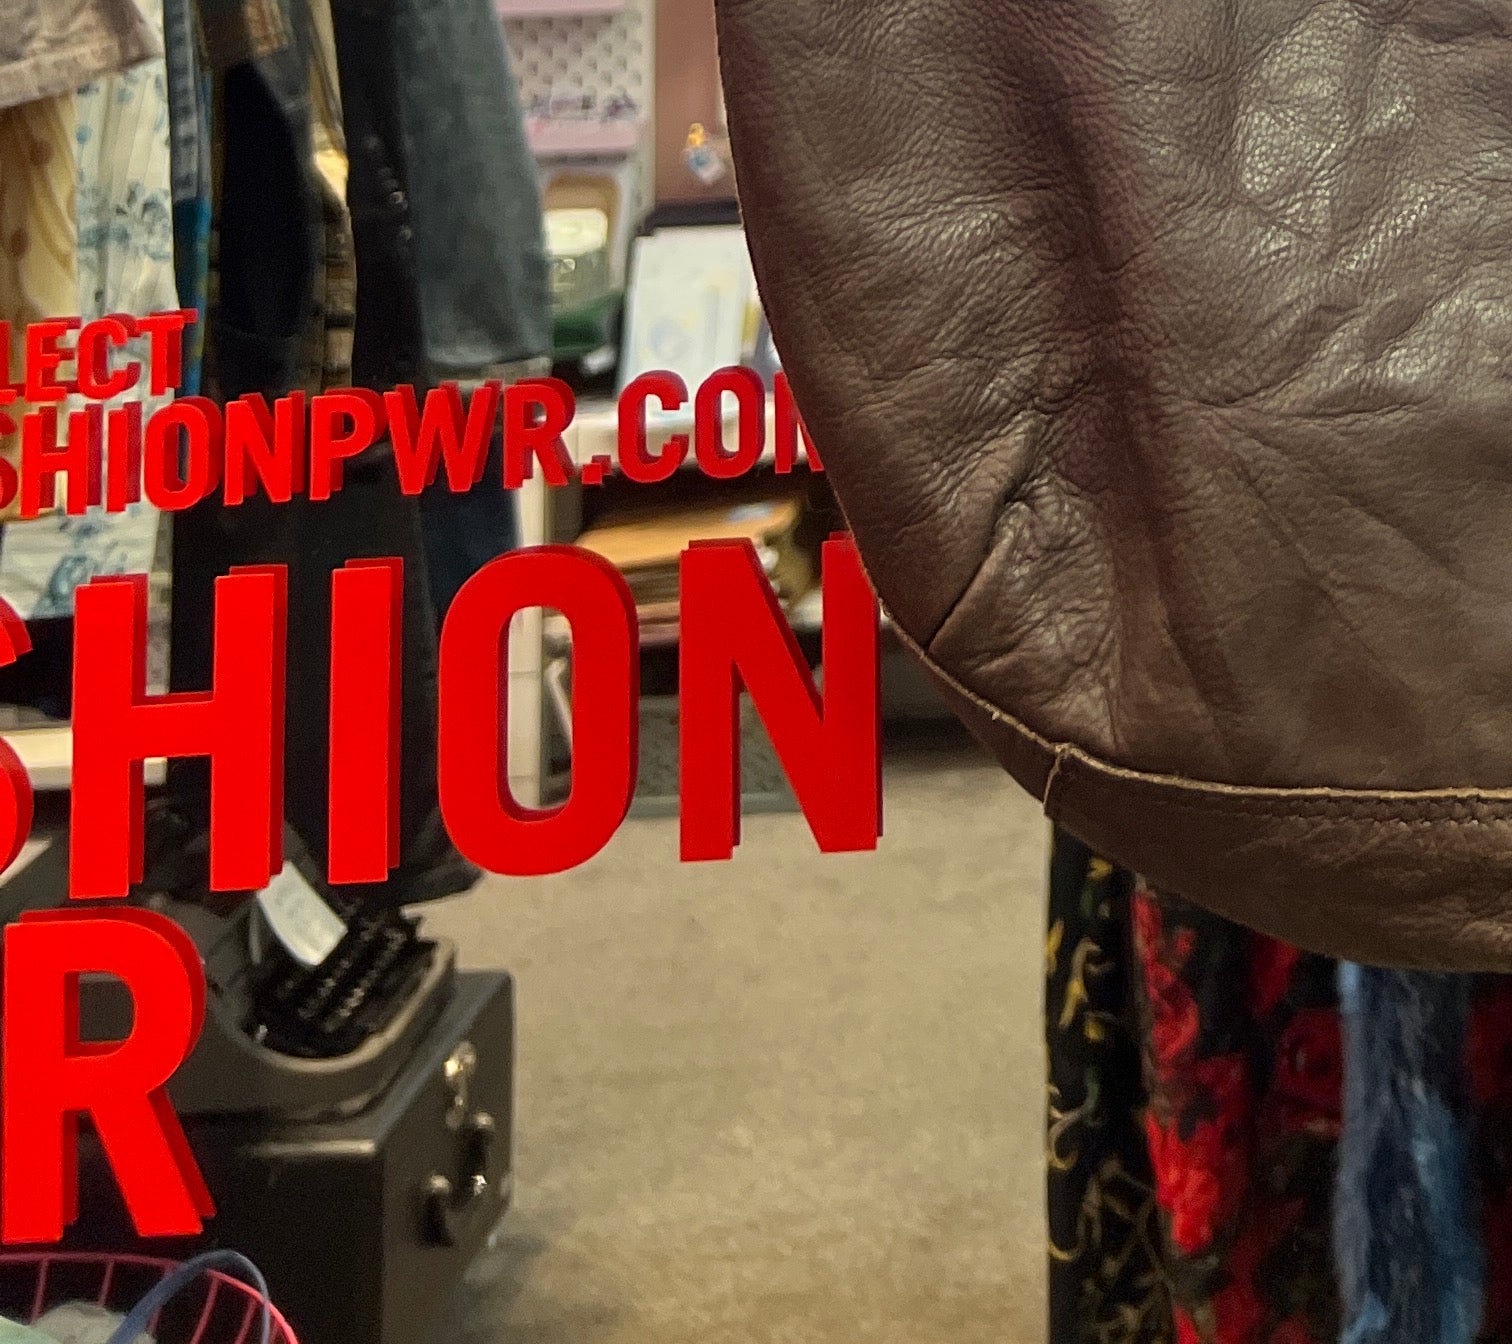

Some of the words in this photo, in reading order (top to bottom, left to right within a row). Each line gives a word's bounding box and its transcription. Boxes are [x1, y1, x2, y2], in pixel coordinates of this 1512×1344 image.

[0, 366, 824, 520] HIONPWR.CO
[0, 536, 881, 902] HION
[2, 915, 206, 1244] R
